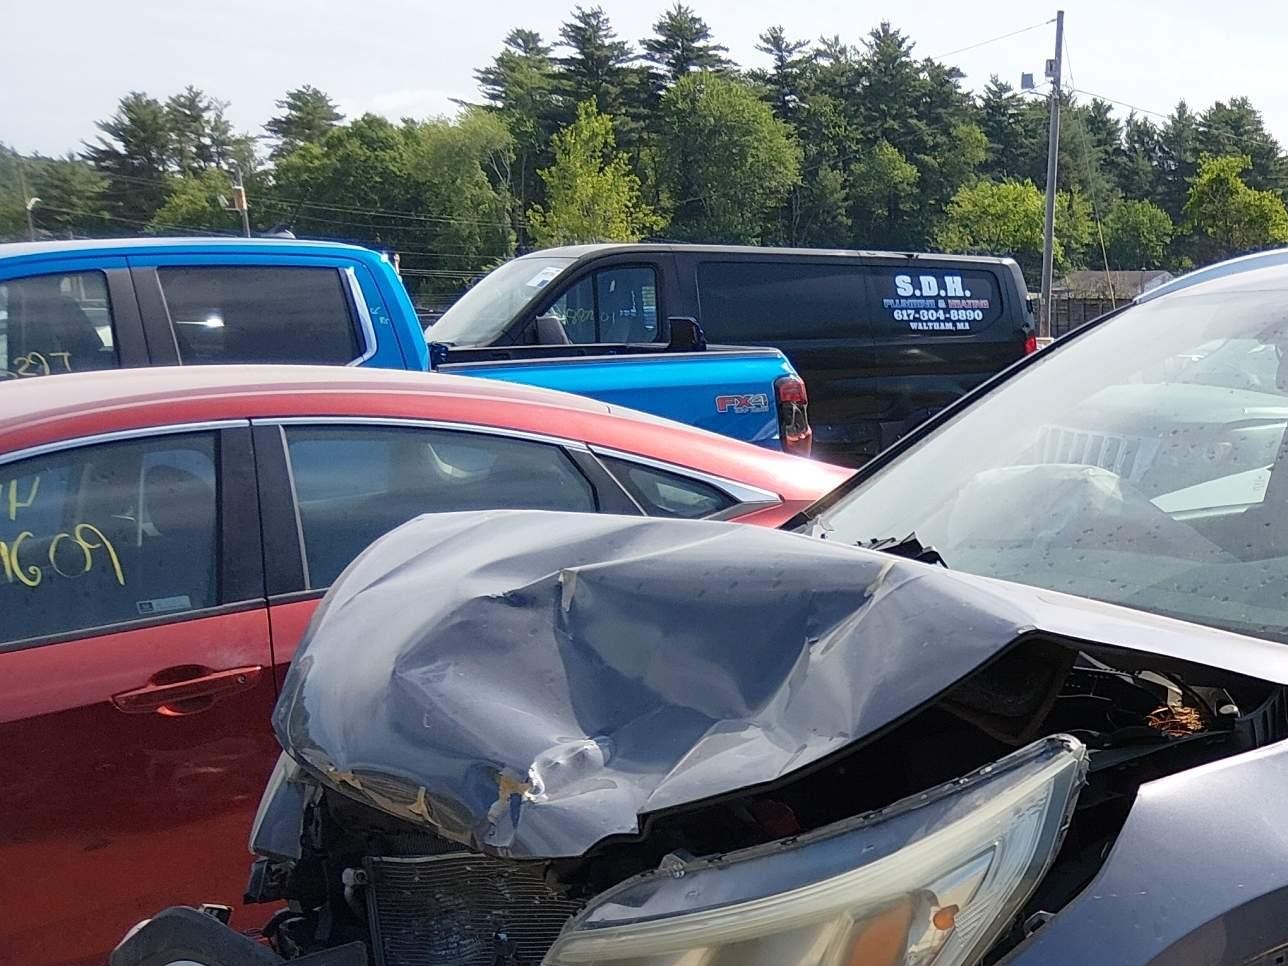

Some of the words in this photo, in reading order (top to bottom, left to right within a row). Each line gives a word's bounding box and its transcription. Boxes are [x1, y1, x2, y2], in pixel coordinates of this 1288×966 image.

[895, 274, 971, 297] S.D.H.
[938, 299, 946, 308] &
[956, 322, 970, 330] MA
[716, 394, 768, 412] FX4
